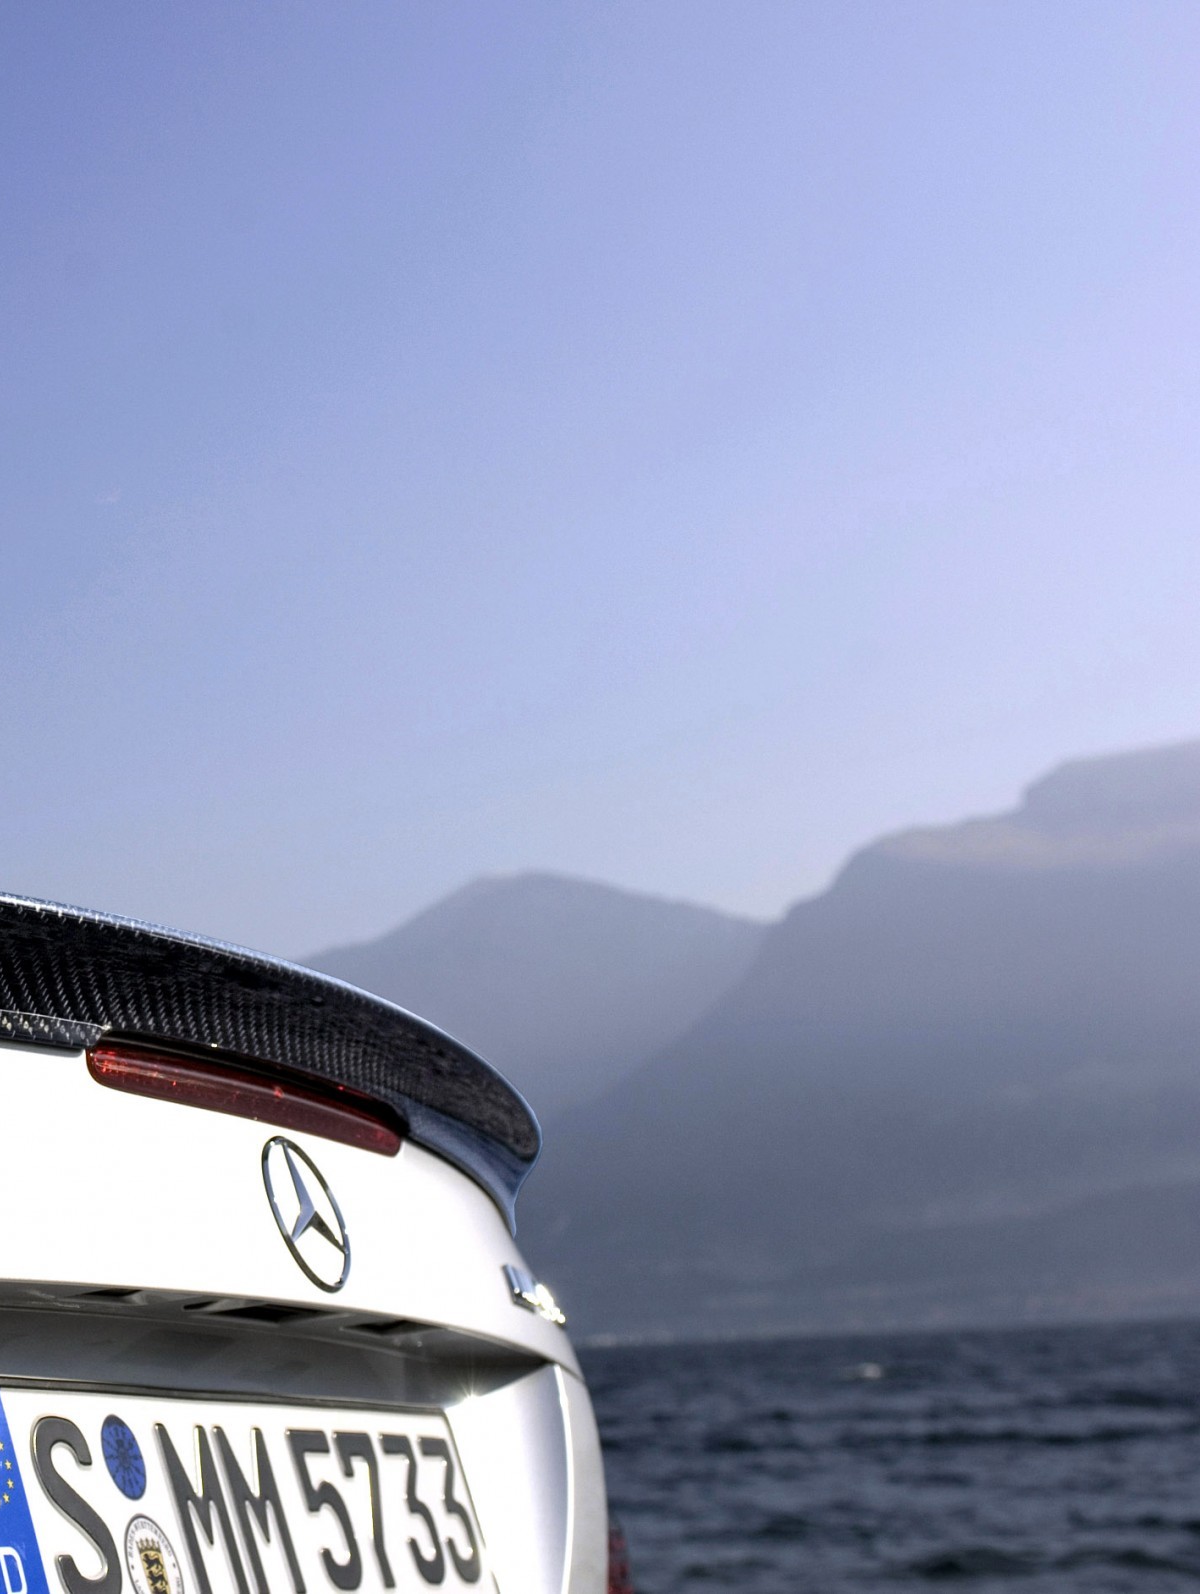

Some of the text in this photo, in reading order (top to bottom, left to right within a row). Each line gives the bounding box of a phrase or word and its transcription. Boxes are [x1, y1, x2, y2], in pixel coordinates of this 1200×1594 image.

[31, 1414, 481, 1594] S MM 5733
